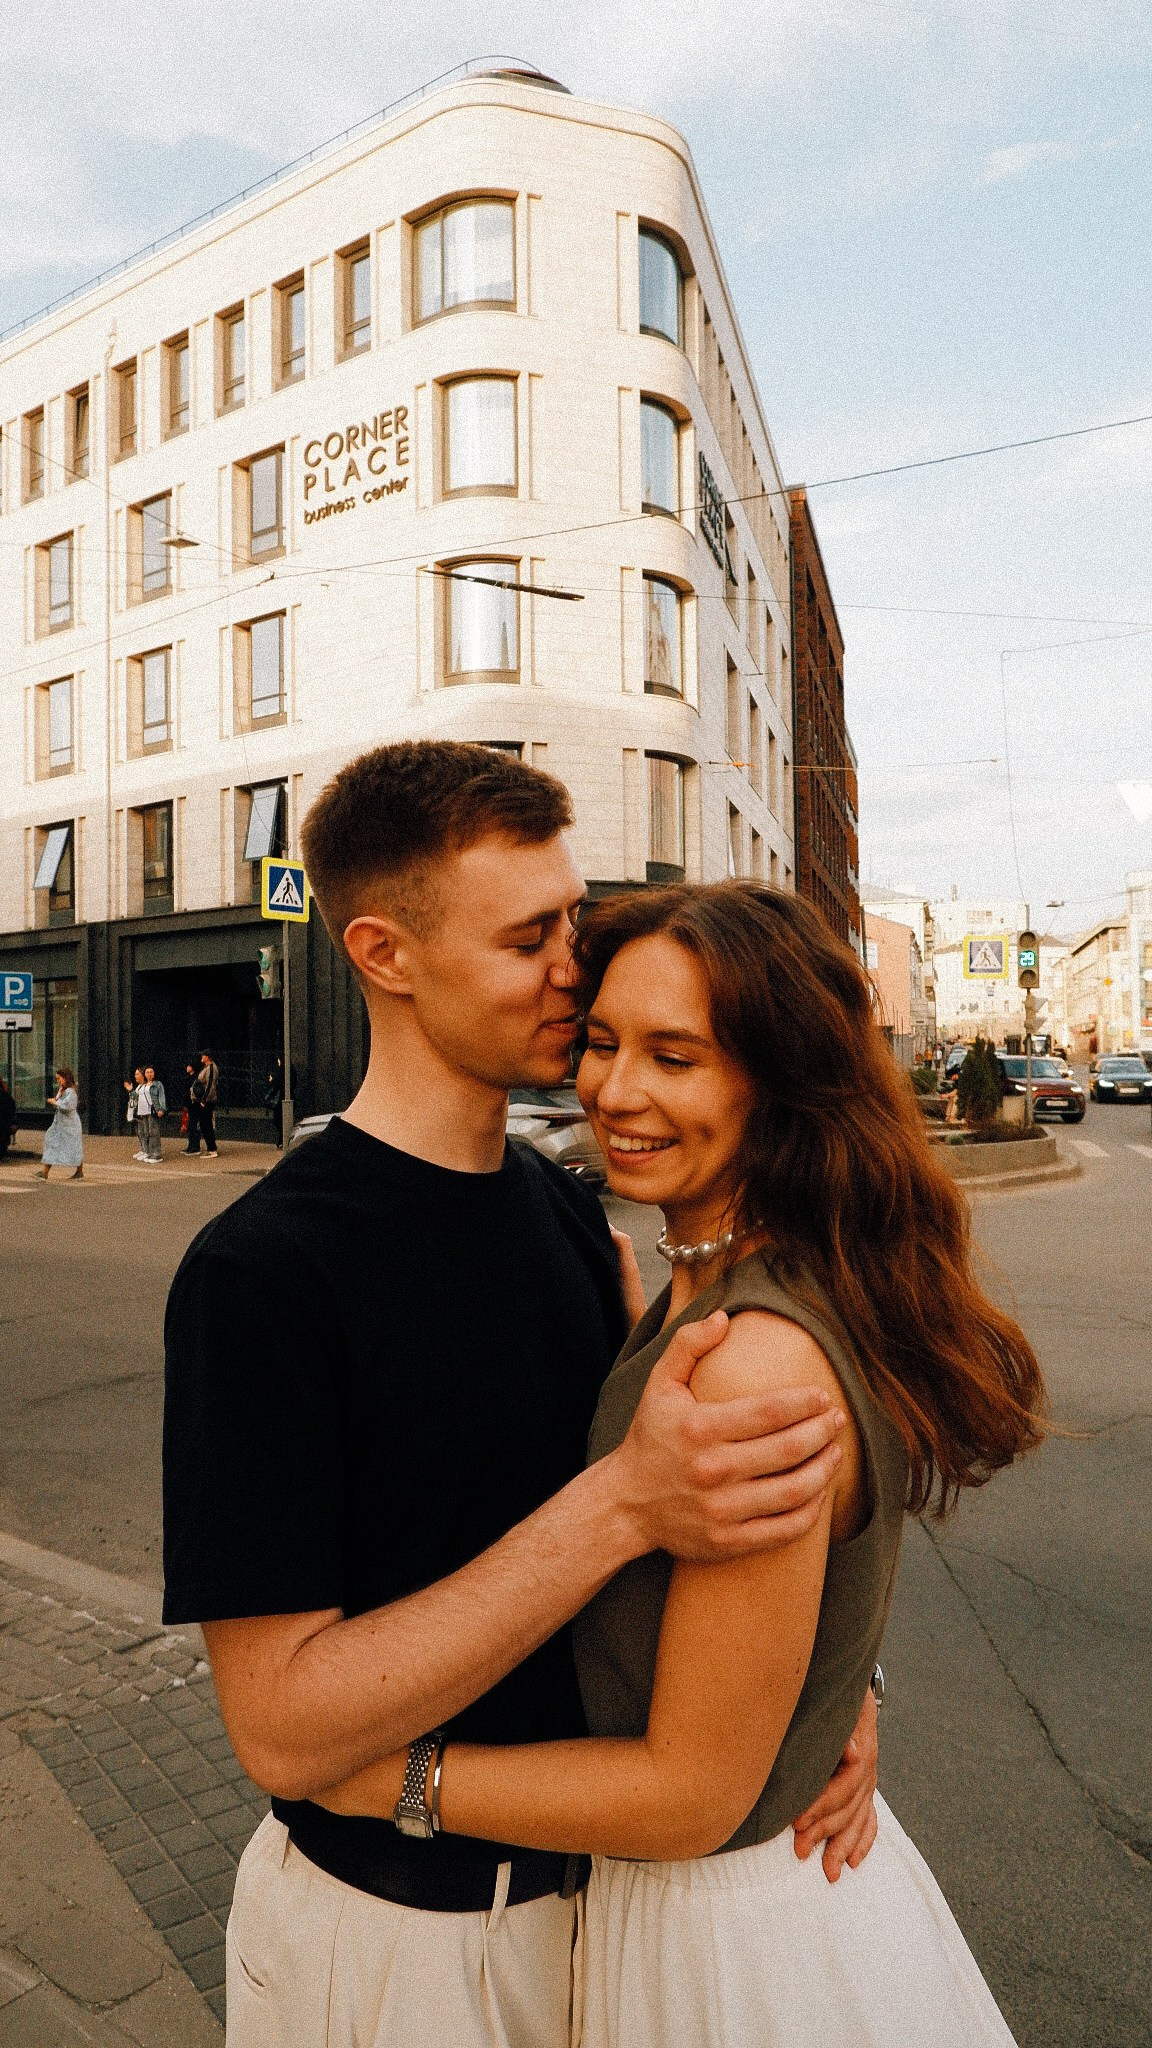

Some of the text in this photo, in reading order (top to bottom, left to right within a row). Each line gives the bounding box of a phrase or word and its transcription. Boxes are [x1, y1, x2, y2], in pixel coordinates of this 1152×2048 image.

[304, 405, 409, 468] CORNER
[304, 436, 410, 501] PLACE
[304, 476, 409, 525] business center
[5, 976, 25, 1006] P
